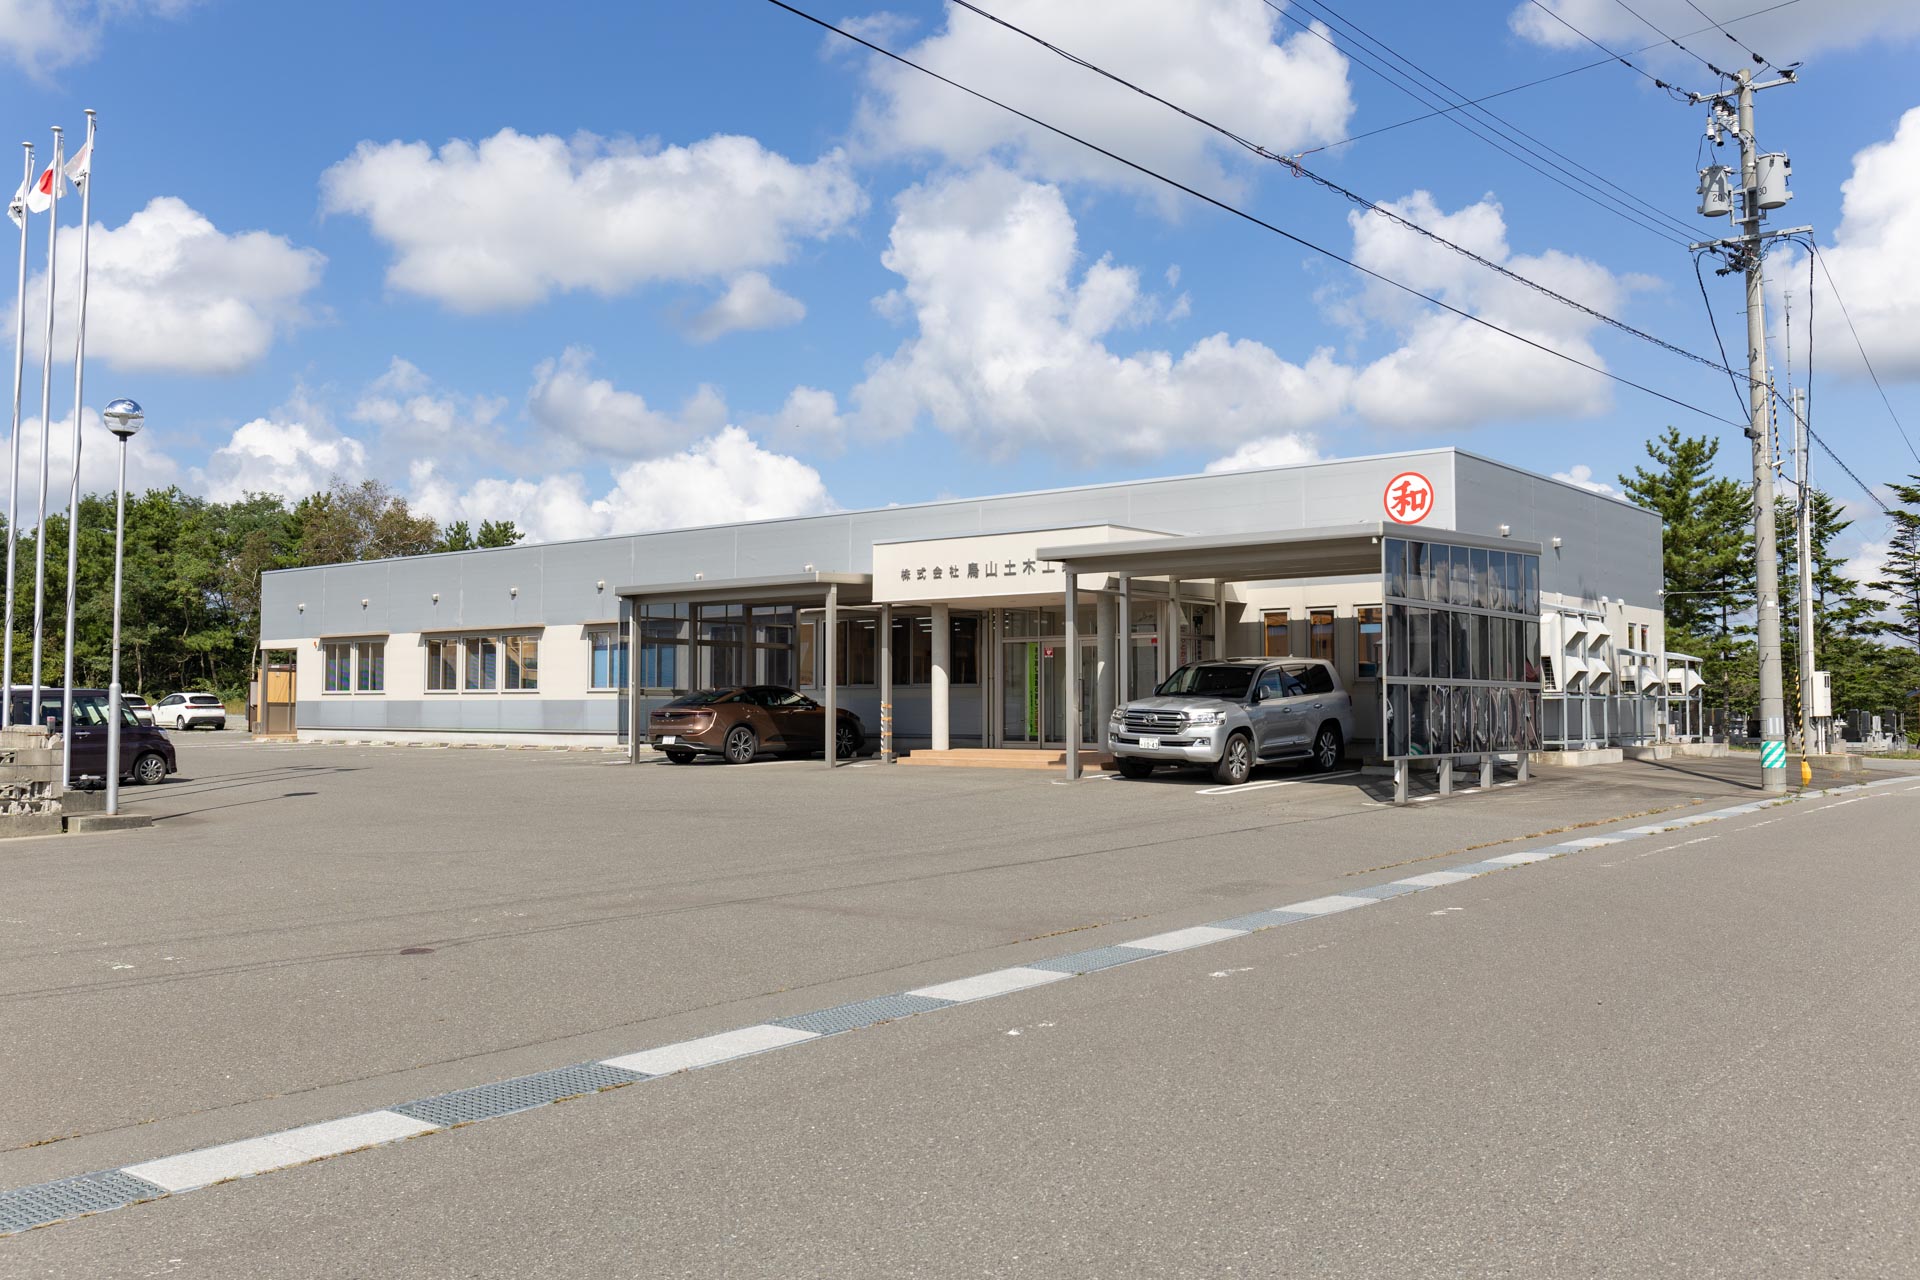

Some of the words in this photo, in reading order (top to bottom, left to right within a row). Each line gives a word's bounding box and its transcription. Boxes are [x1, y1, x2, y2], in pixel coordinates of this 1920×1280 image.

[1712, 193, 1723, 203] 20
[1759, 186, 1767, 196] 30
[1390, 480, 1428, 517] 和
[900, 558, 1066, 582] 株式会社鳥山土木工
